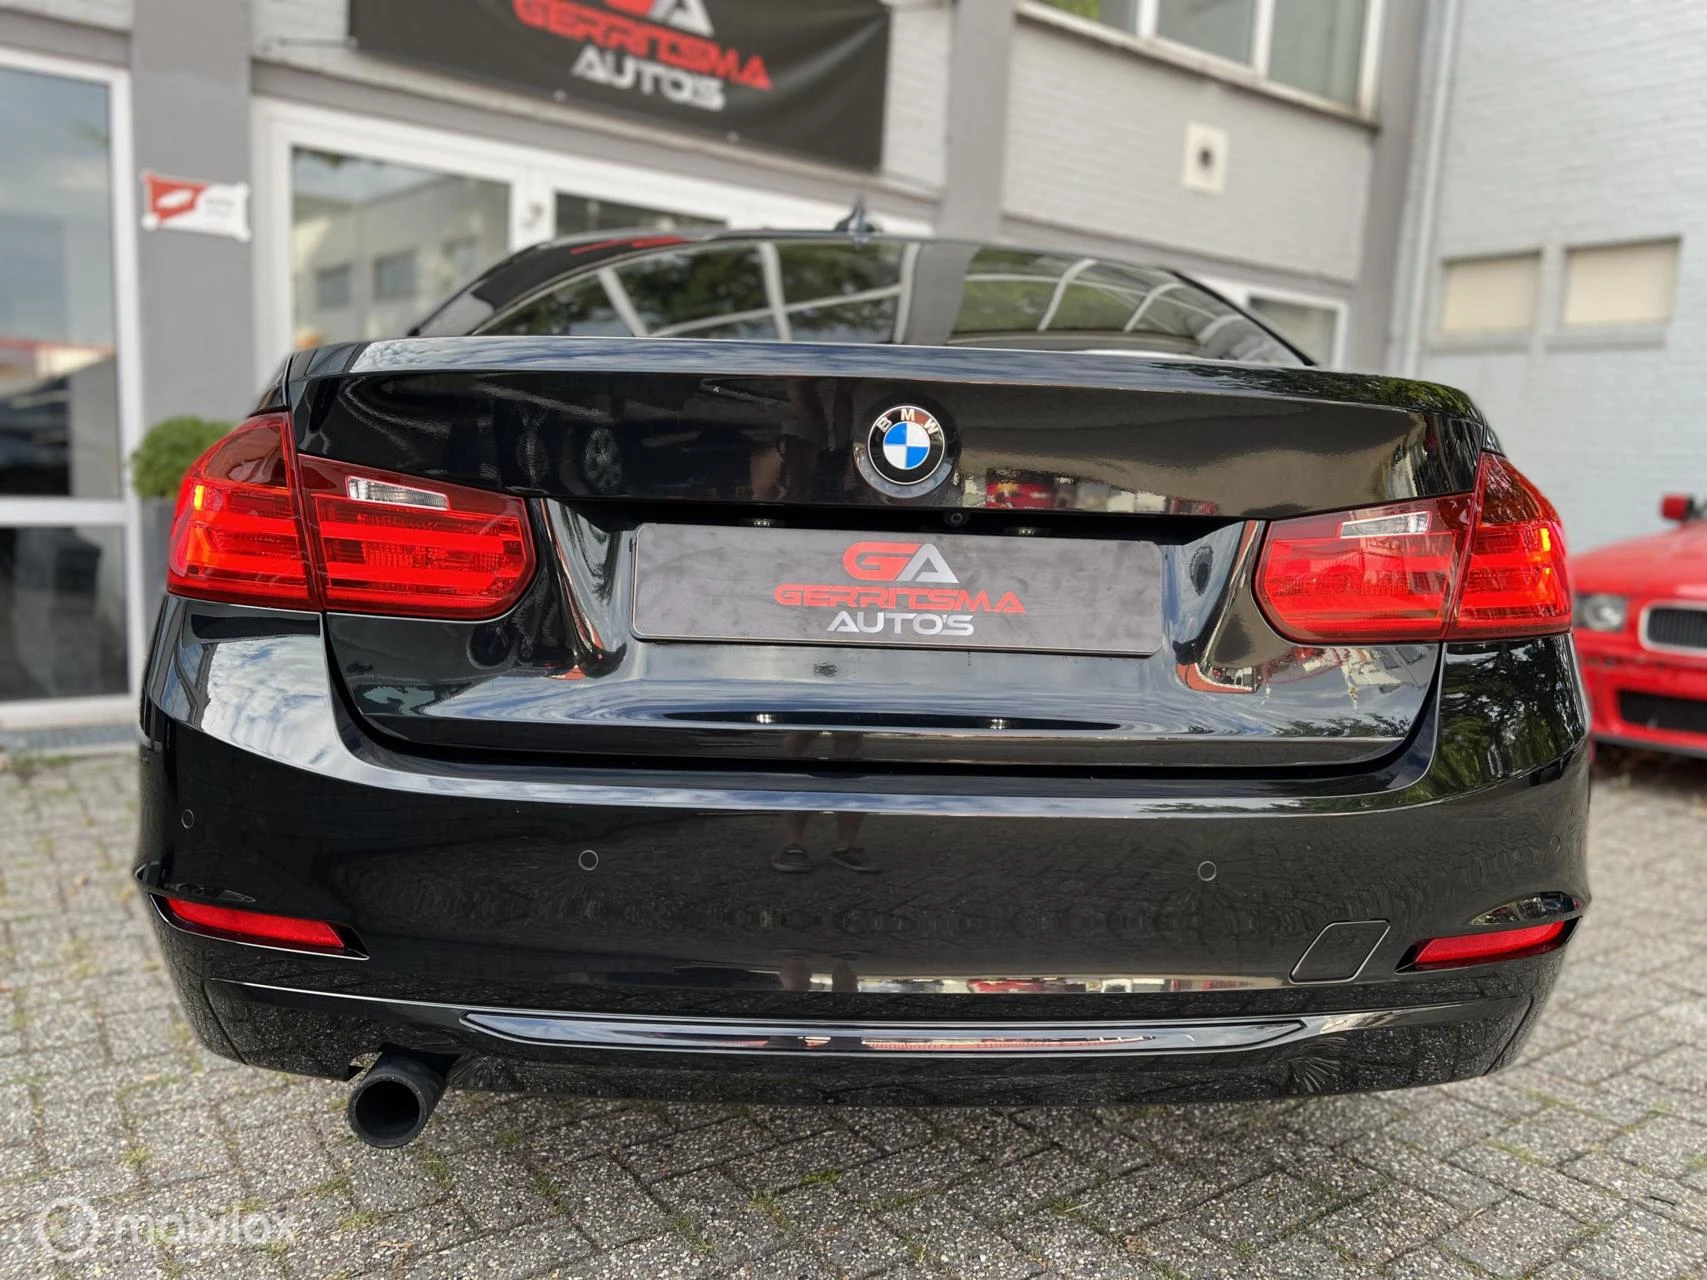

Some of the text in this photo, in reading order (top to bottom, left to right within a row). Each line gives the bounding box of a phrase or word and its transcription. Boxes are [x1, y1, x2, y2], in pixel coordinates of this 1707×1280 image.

[604, 0, 715, 37] A
[876, 408, 939, 433] BMW
[842, 541, 959, 584] GA
[774, 583, 1026, 614] GERRITSMA
[826, 610, 974, 636] AUTO'S
